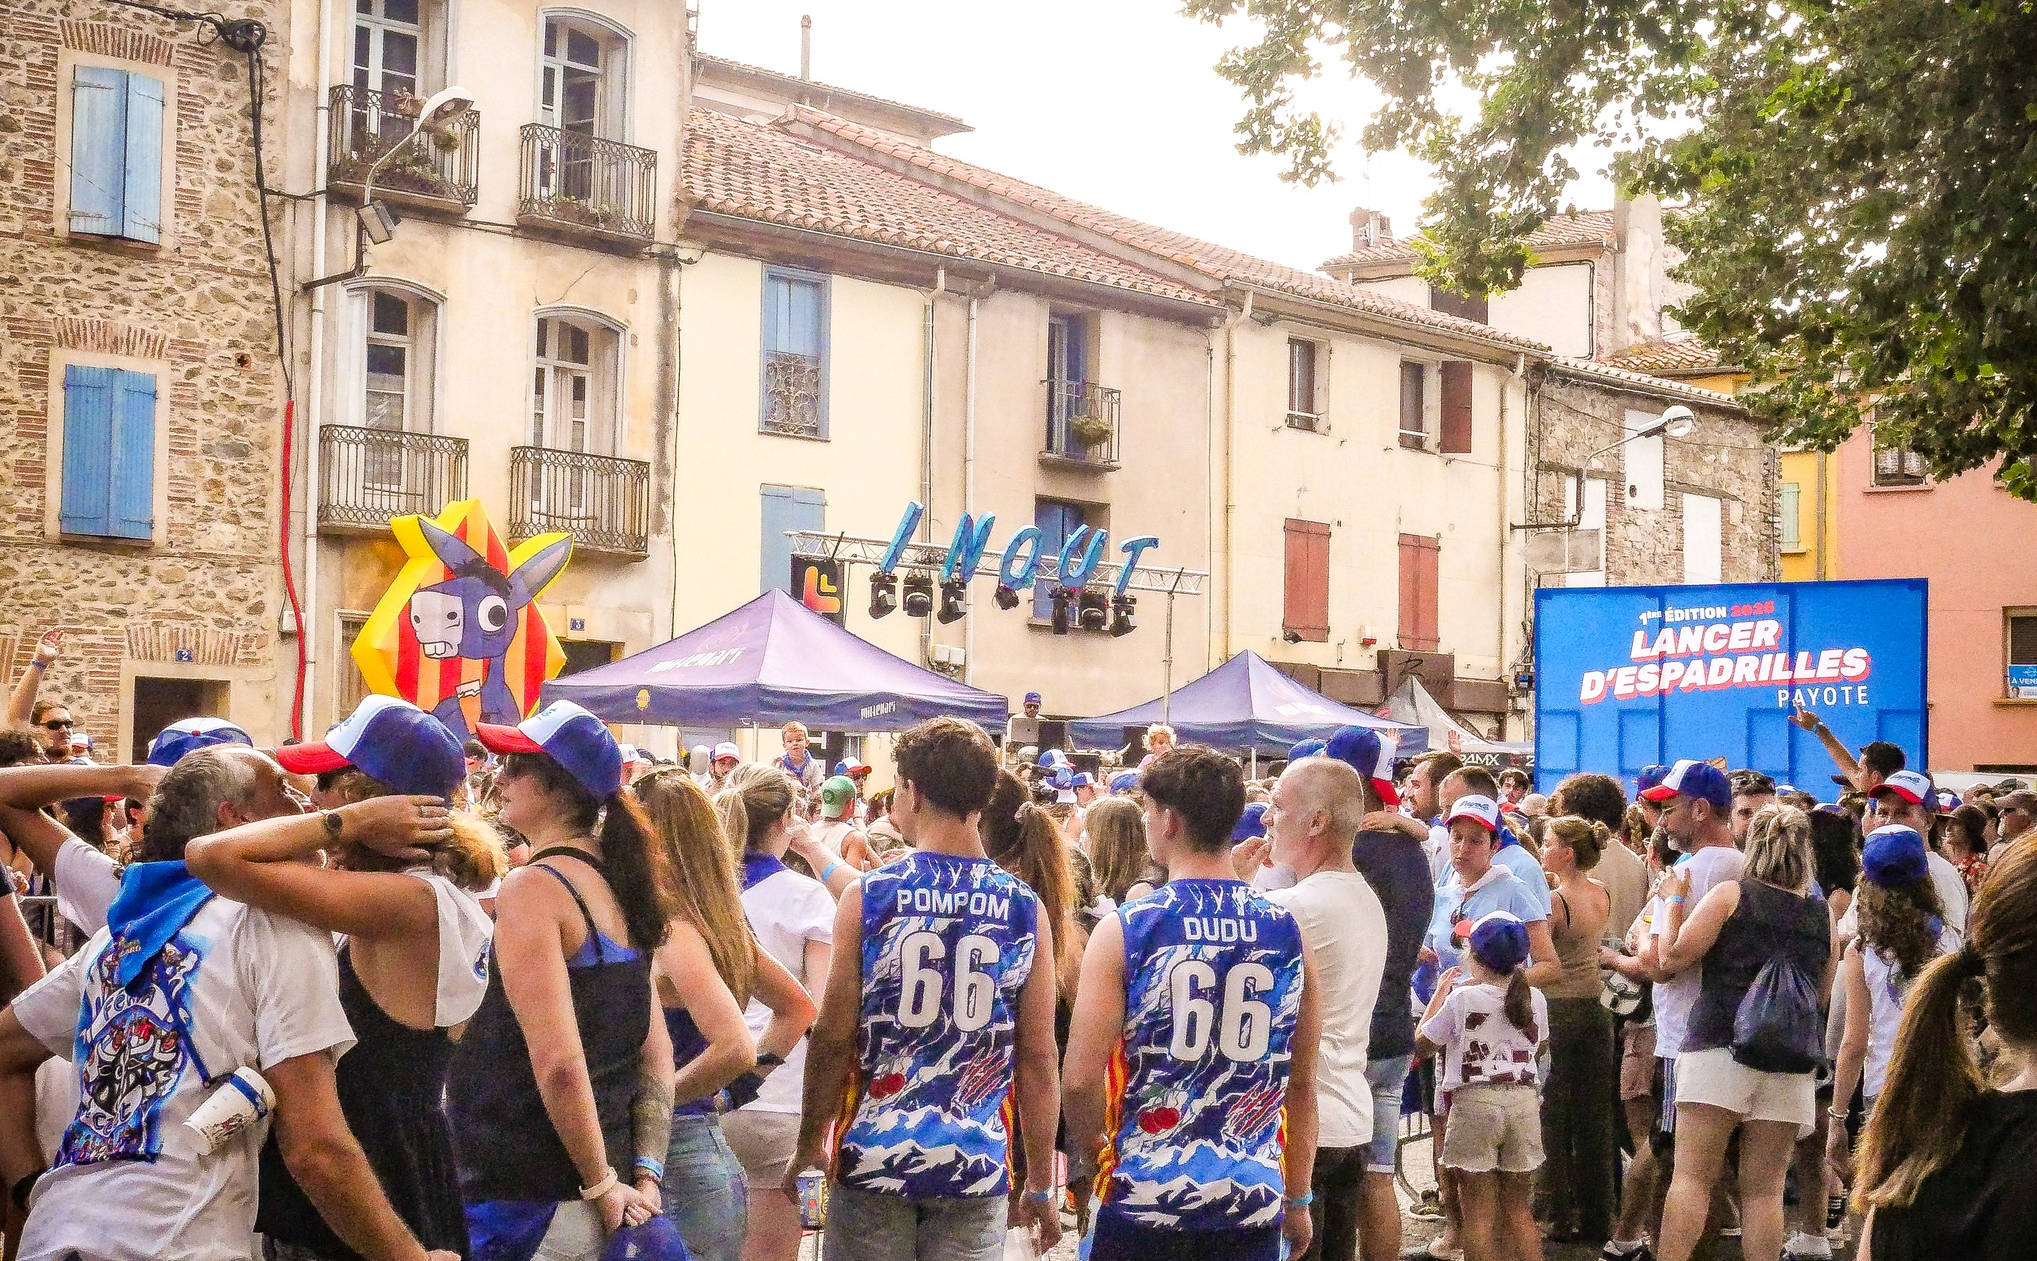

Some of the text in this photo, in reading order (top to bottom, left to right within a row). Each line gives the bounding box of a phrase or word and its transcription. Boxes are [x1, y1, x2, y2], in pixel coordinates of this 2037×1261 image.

[575, 620, 581, 629] 3
[1664, 605, 1727, 622] ÉDITION
[1630, 619, 1781, 660] LANCER
[182, 651, 188, 660] 2
[1579, 648, 1871, 703] D'ESPADRILLES
[1778, 685, 1869, 708] PAYOTE
[896, 887, 1010, 922] POMPOM
[1183, 916, 1258, 943] DUDU
[898, 931, 1000, 1032] 66
[1169, 960, 1275, 1062] 66
